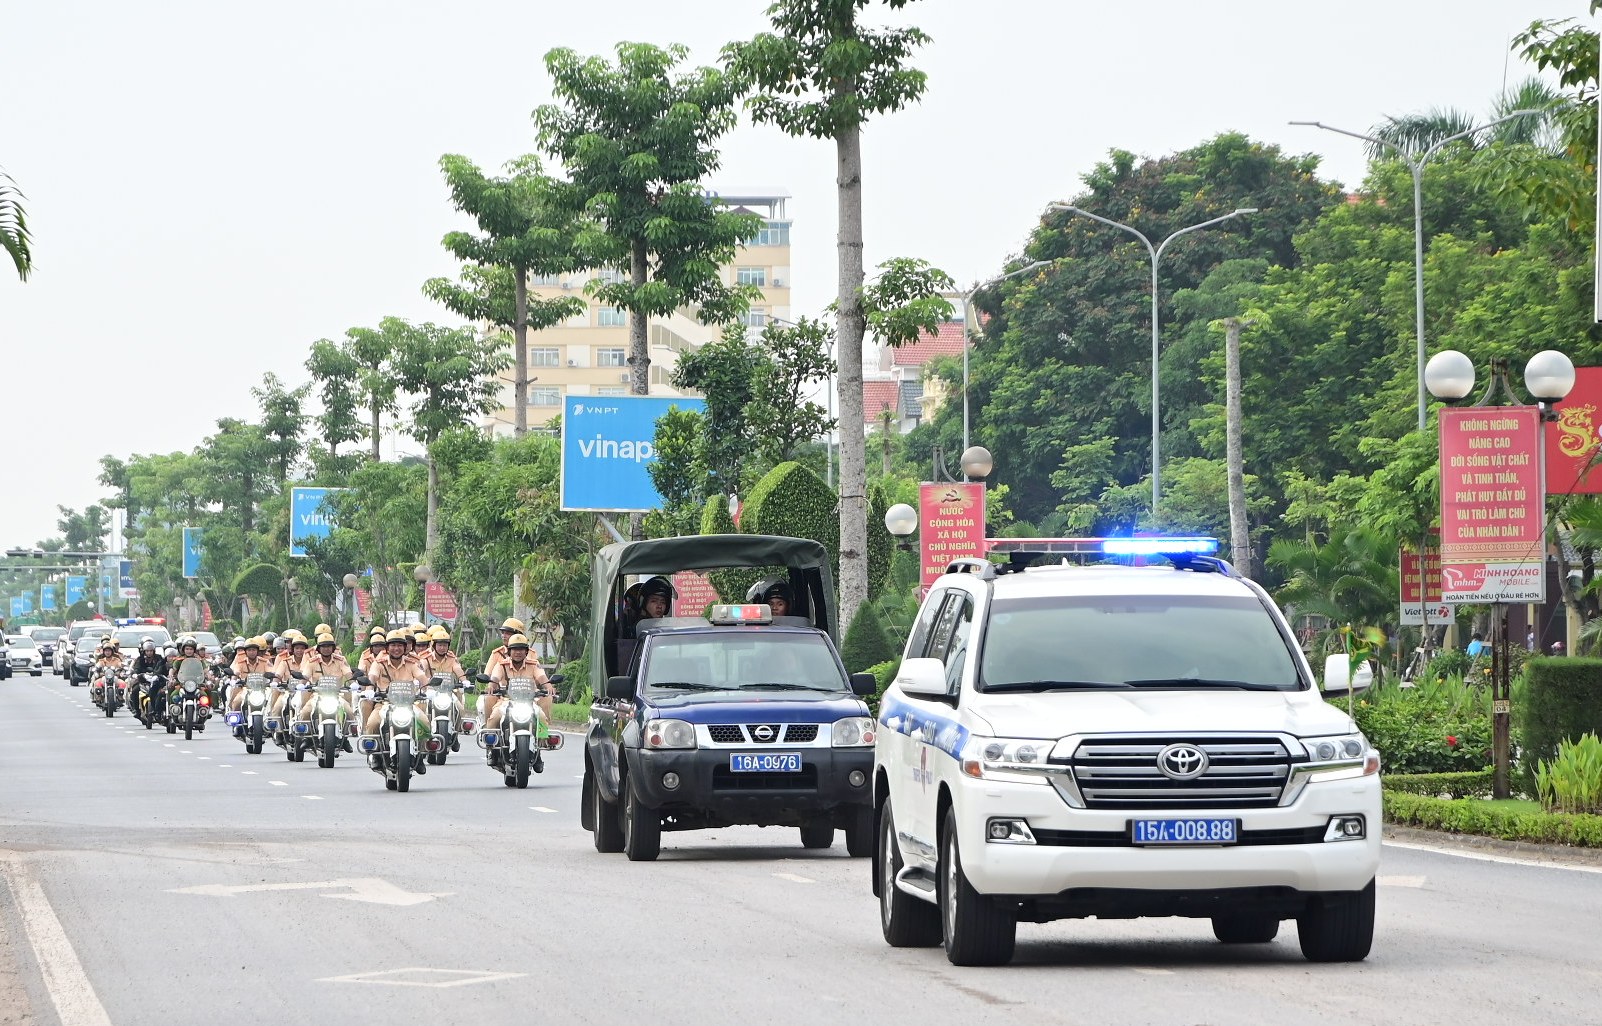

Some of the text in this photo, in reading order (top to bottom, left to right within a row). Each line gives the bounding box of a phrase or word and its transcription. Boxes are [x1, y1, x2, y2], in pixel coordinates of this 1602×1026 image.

[1460, 417, 1519, 431] KHÔNG NGỪNG
[578, 434, 654, 463] vinap
[1469, 436, 1511, 449] NÂNG CAO
[1451, 451, 1530, 468] ĐỜI SỐNG VẬT CHẤT
[1461, 472, 1473, 485] VÀ
[1474, 473, 1493, 484] TINH
[1455, 489, 1477, 503] PHÁT
[1478, 491, 1495, 502] HUY
[1514, 486, 1526, 501] ĐỦ
[1456, 504, 1526, 520] VAI TRÒ LÀM CHỦ
[929, 517, 975, 528] CỘNG HÒA
[937, 530, 967, 540] XÃ HỘI
[1458, 524, 1475, 538] CỦA
[1476, 524, 1500, 537] NHÂN
[1501, 524, 1519, 537] DÂN
[928, 541, 977, 551] CHỦ NGHĨA
[931, 553, 951, 564] VIỆT
[925, 565, 947, 575] MUÔ
[1473, 568, 1501, 579] MINH
[1499, 578, 1530, 586] MOBILE
[1404, 608, 1437, 616] Vietott
[738, 755, 797, 769] 16A-0976
[1138, 820, 1233, 841] 15A-008.88
